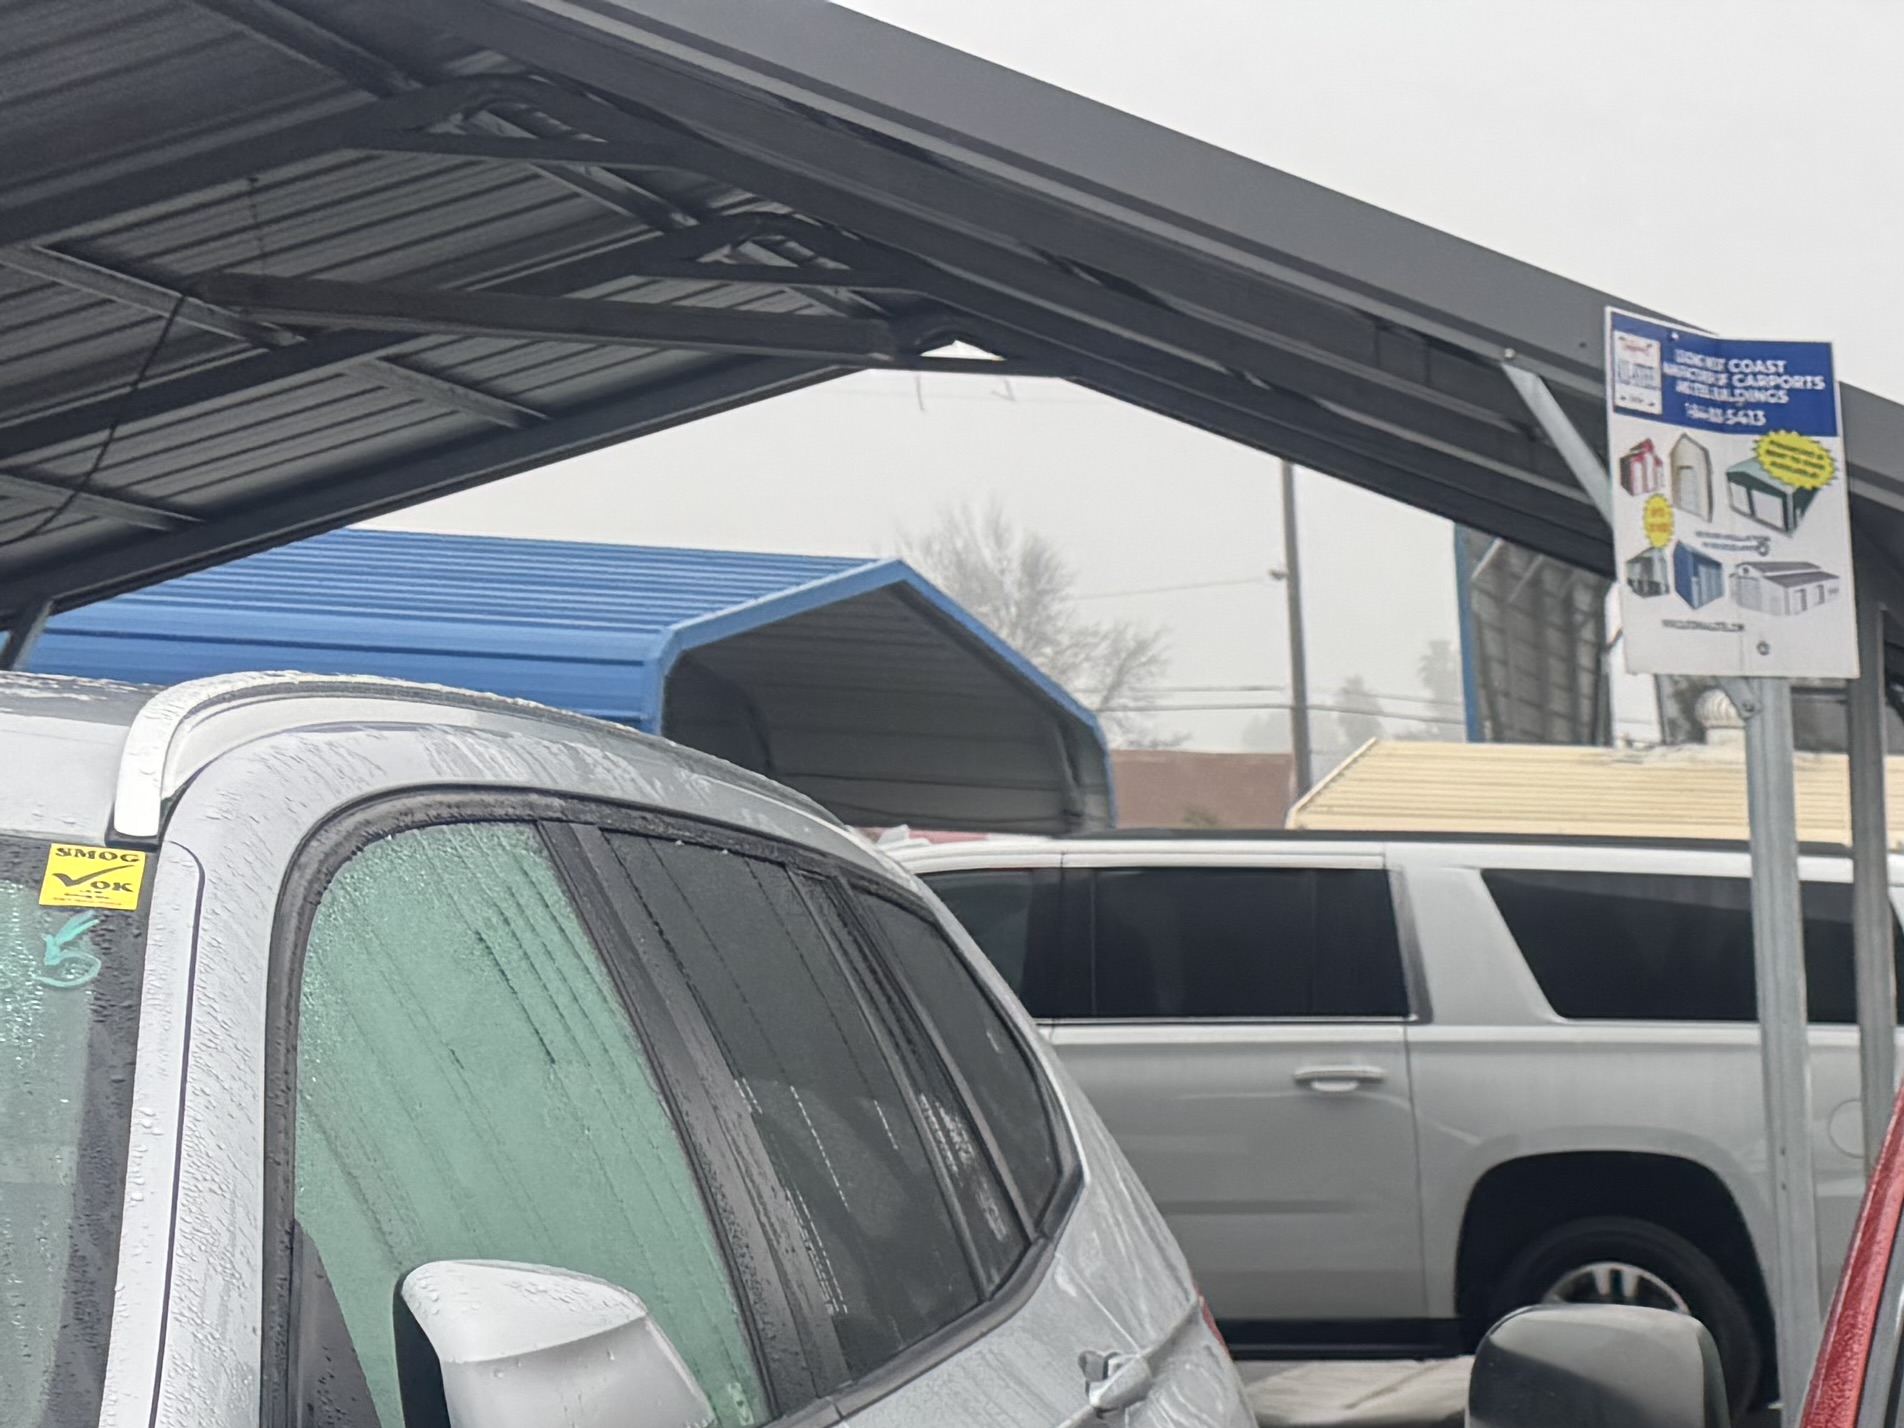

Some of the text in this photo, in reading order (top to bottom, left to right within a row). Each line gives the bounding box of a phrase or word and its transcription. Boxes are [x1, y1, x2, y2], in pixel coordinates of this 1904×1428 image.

[1728, 358, 1787, 374] COAST
[1732, 373, 1826, 391] CARPORTS
[91, 880, 134, 893] OK
